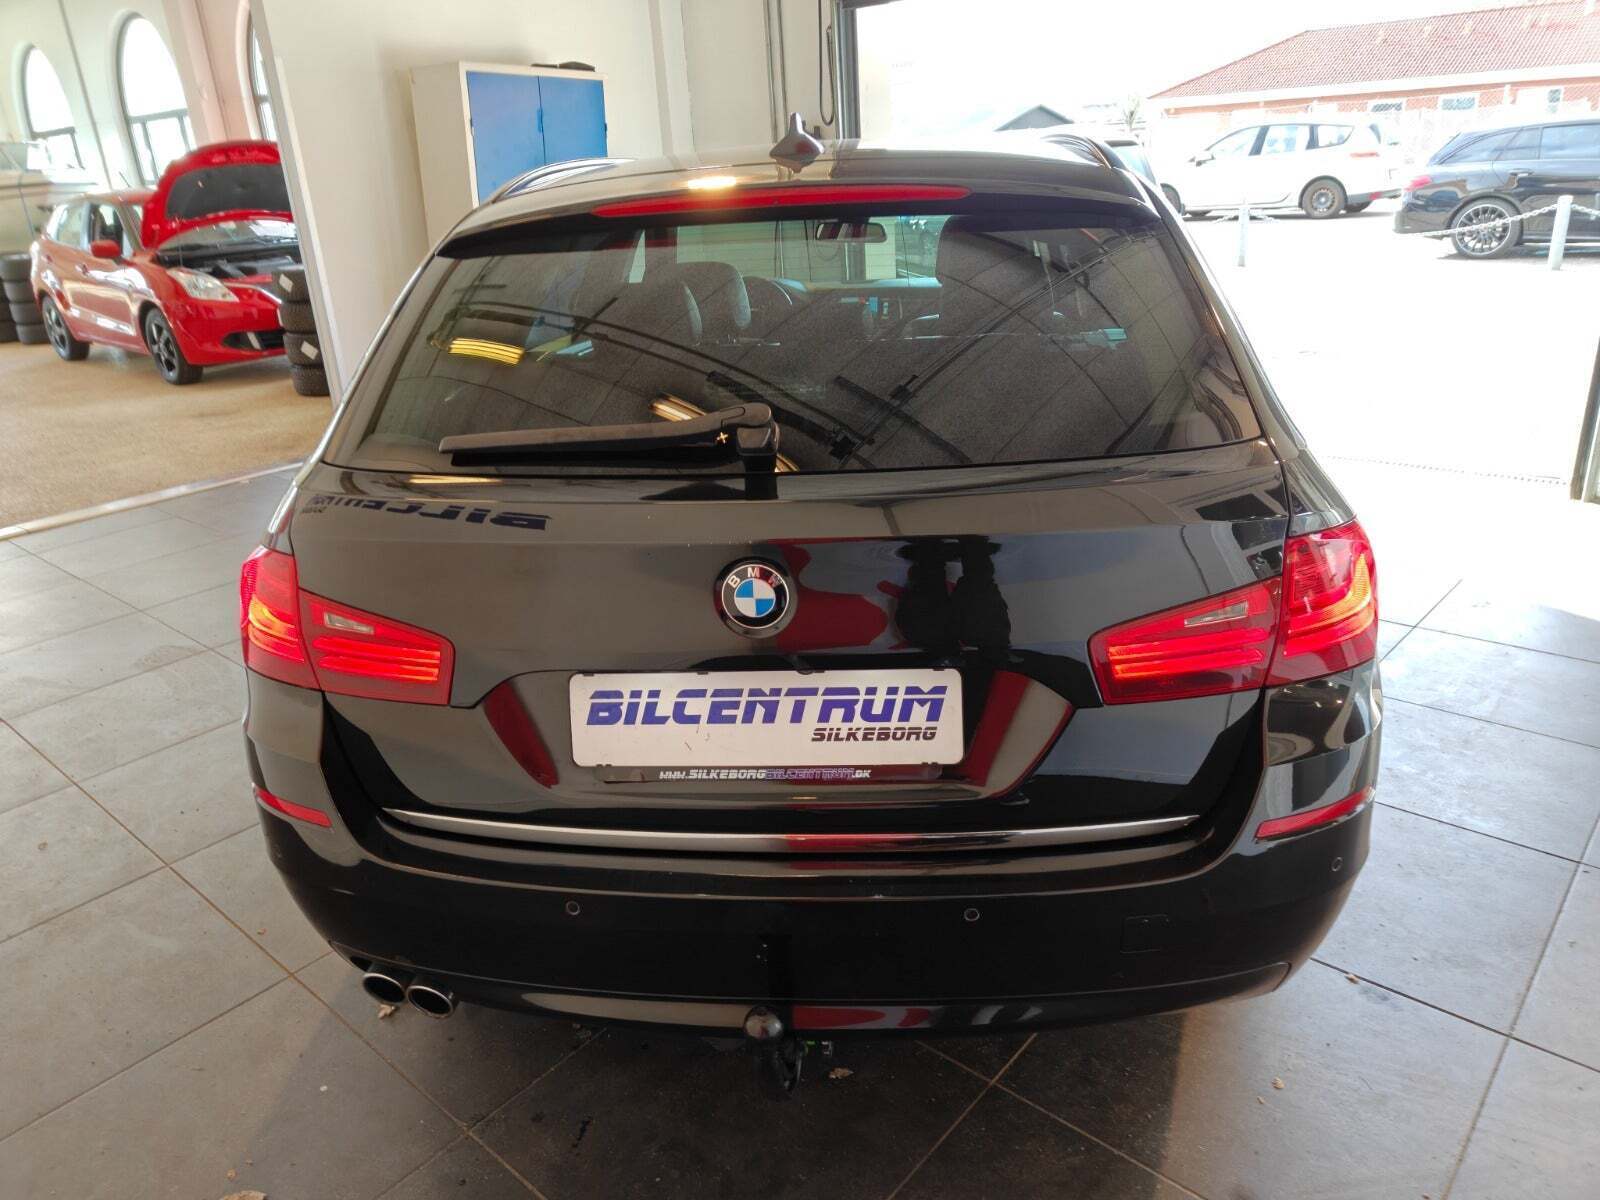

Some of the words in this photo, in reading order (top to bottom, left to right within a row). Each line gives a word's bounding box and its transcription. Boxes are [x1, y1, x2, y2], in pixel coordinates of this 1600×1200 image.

[727, 566, 783, 589] BMW
[586, 685, 949, 726] BILCENTRUM
[811, 727, 937, 742] SILKEBORG
